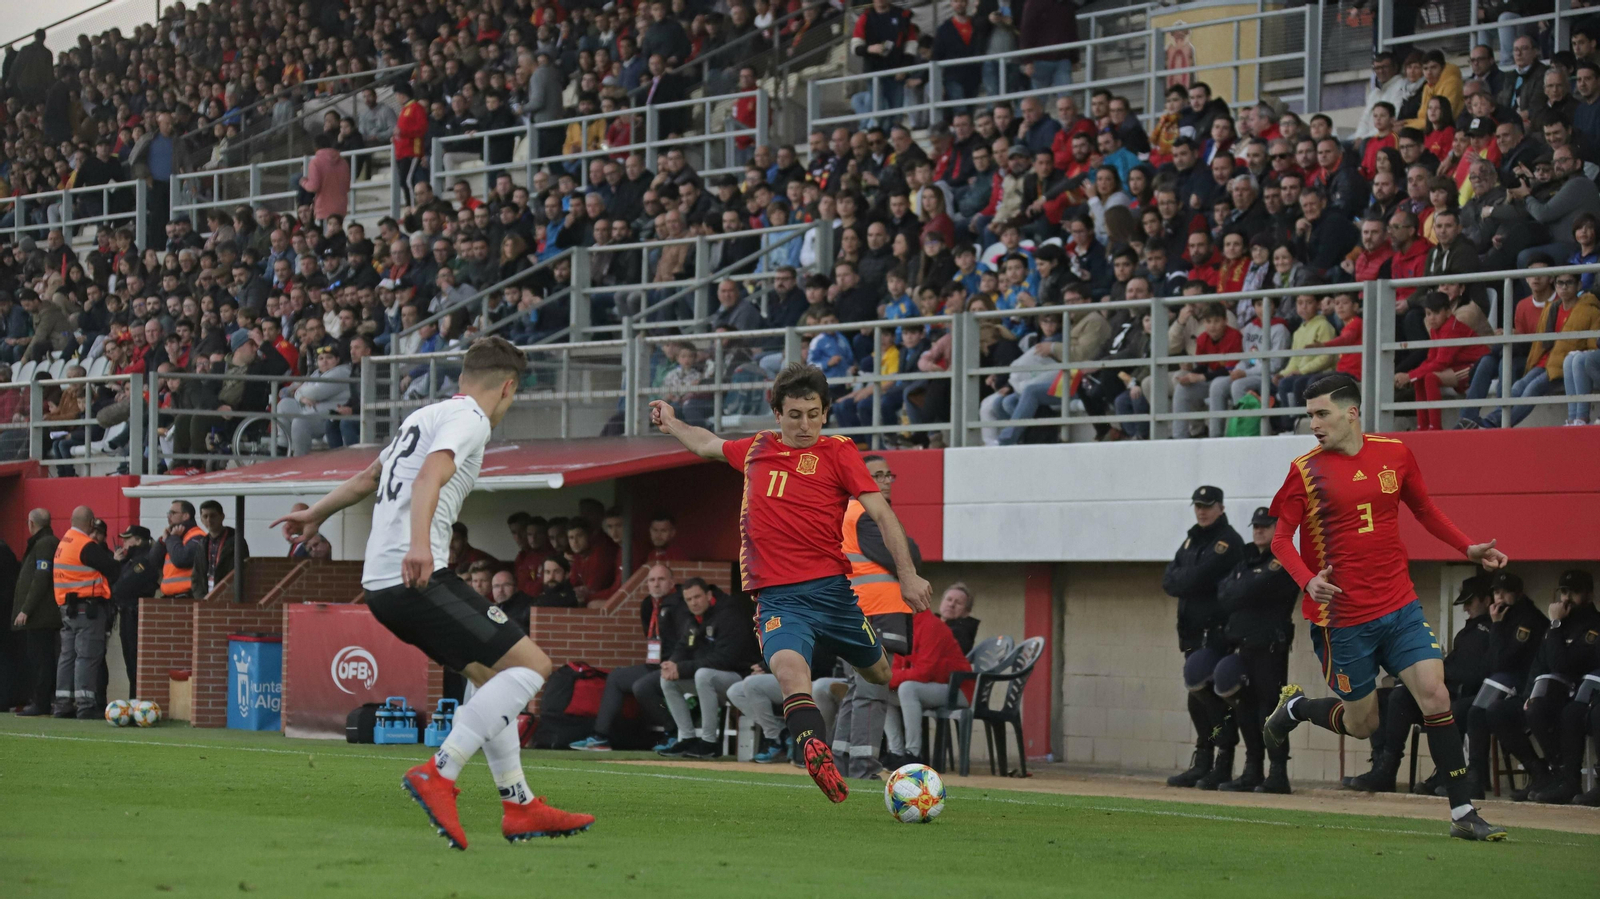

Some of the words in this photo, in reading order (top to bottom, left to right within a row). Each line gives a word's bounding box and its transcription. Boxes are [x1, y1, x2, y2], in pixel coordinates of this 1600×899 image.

[766, 470, 789, 497] 11
[1356, 502, 1374, 534] 3
[338, 661, 369, 680] OFB
